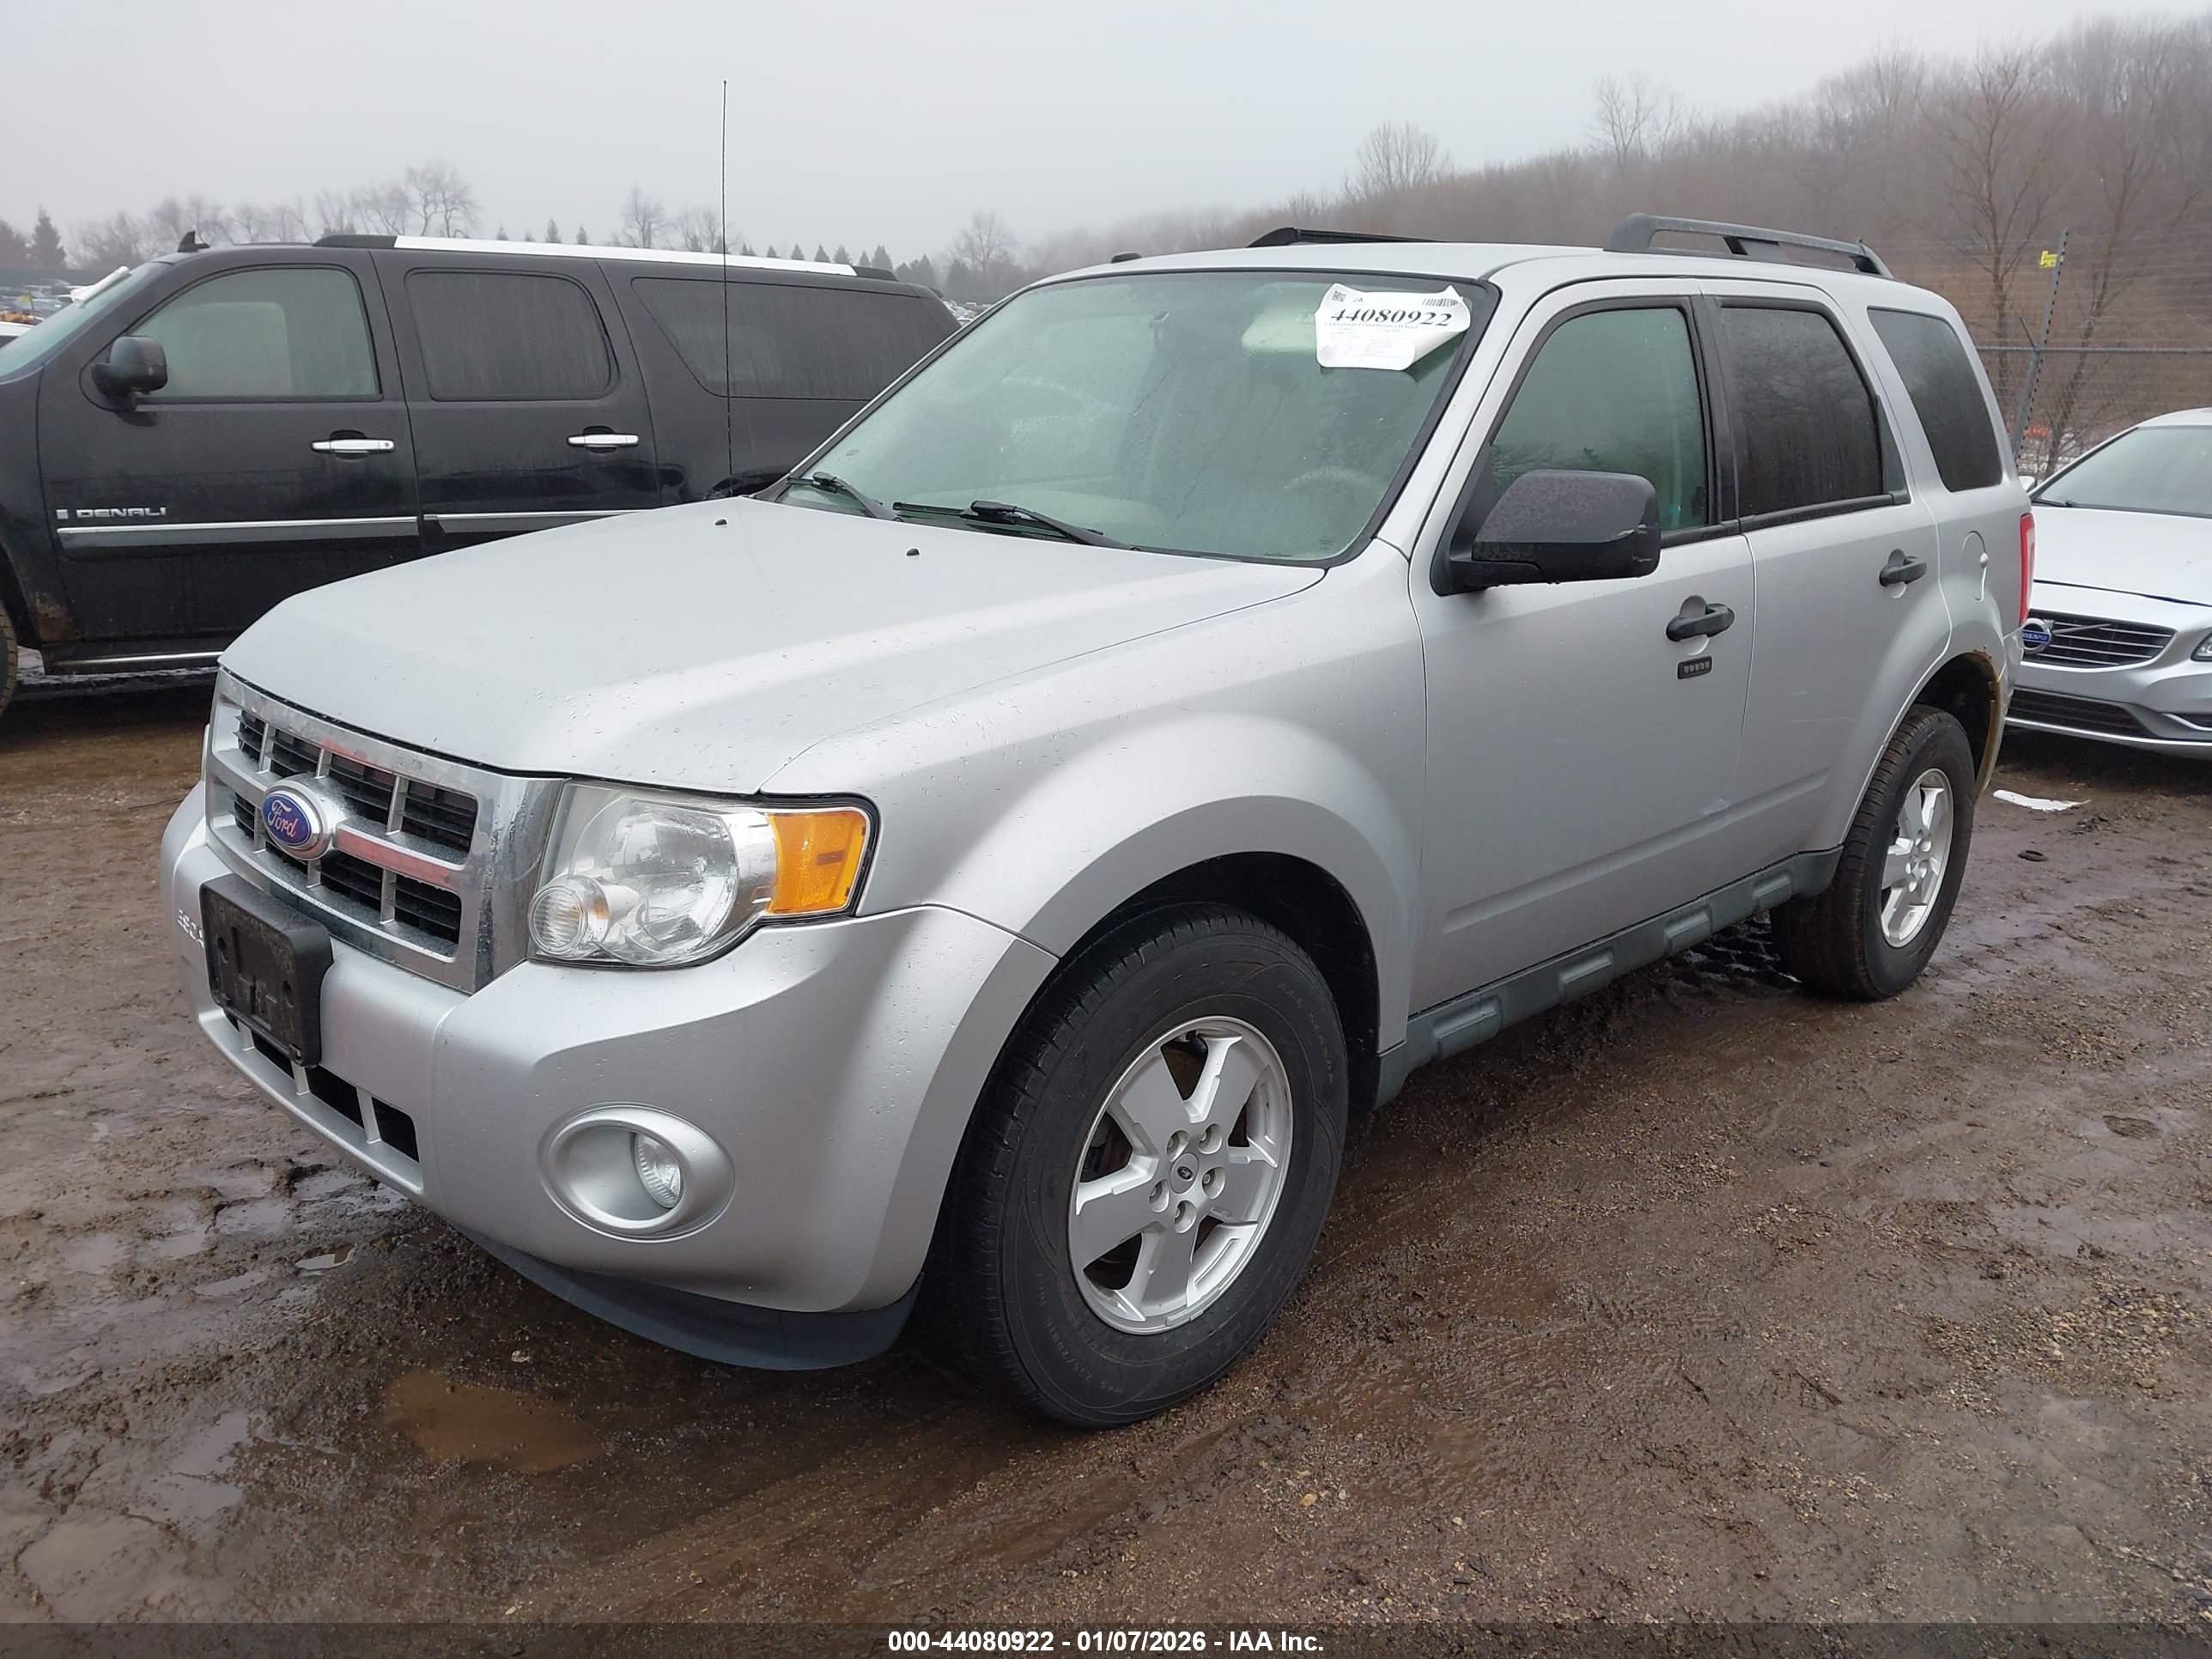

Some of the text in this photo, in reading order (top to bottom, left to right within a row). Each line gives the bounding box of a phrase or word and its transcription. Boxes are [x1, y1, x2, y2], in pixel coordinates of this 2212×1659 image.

[1331, 308, 1452, 327] 44080922
[76, 507, 167, 519] DENALI
[267, 799, 299, 838] Ford
